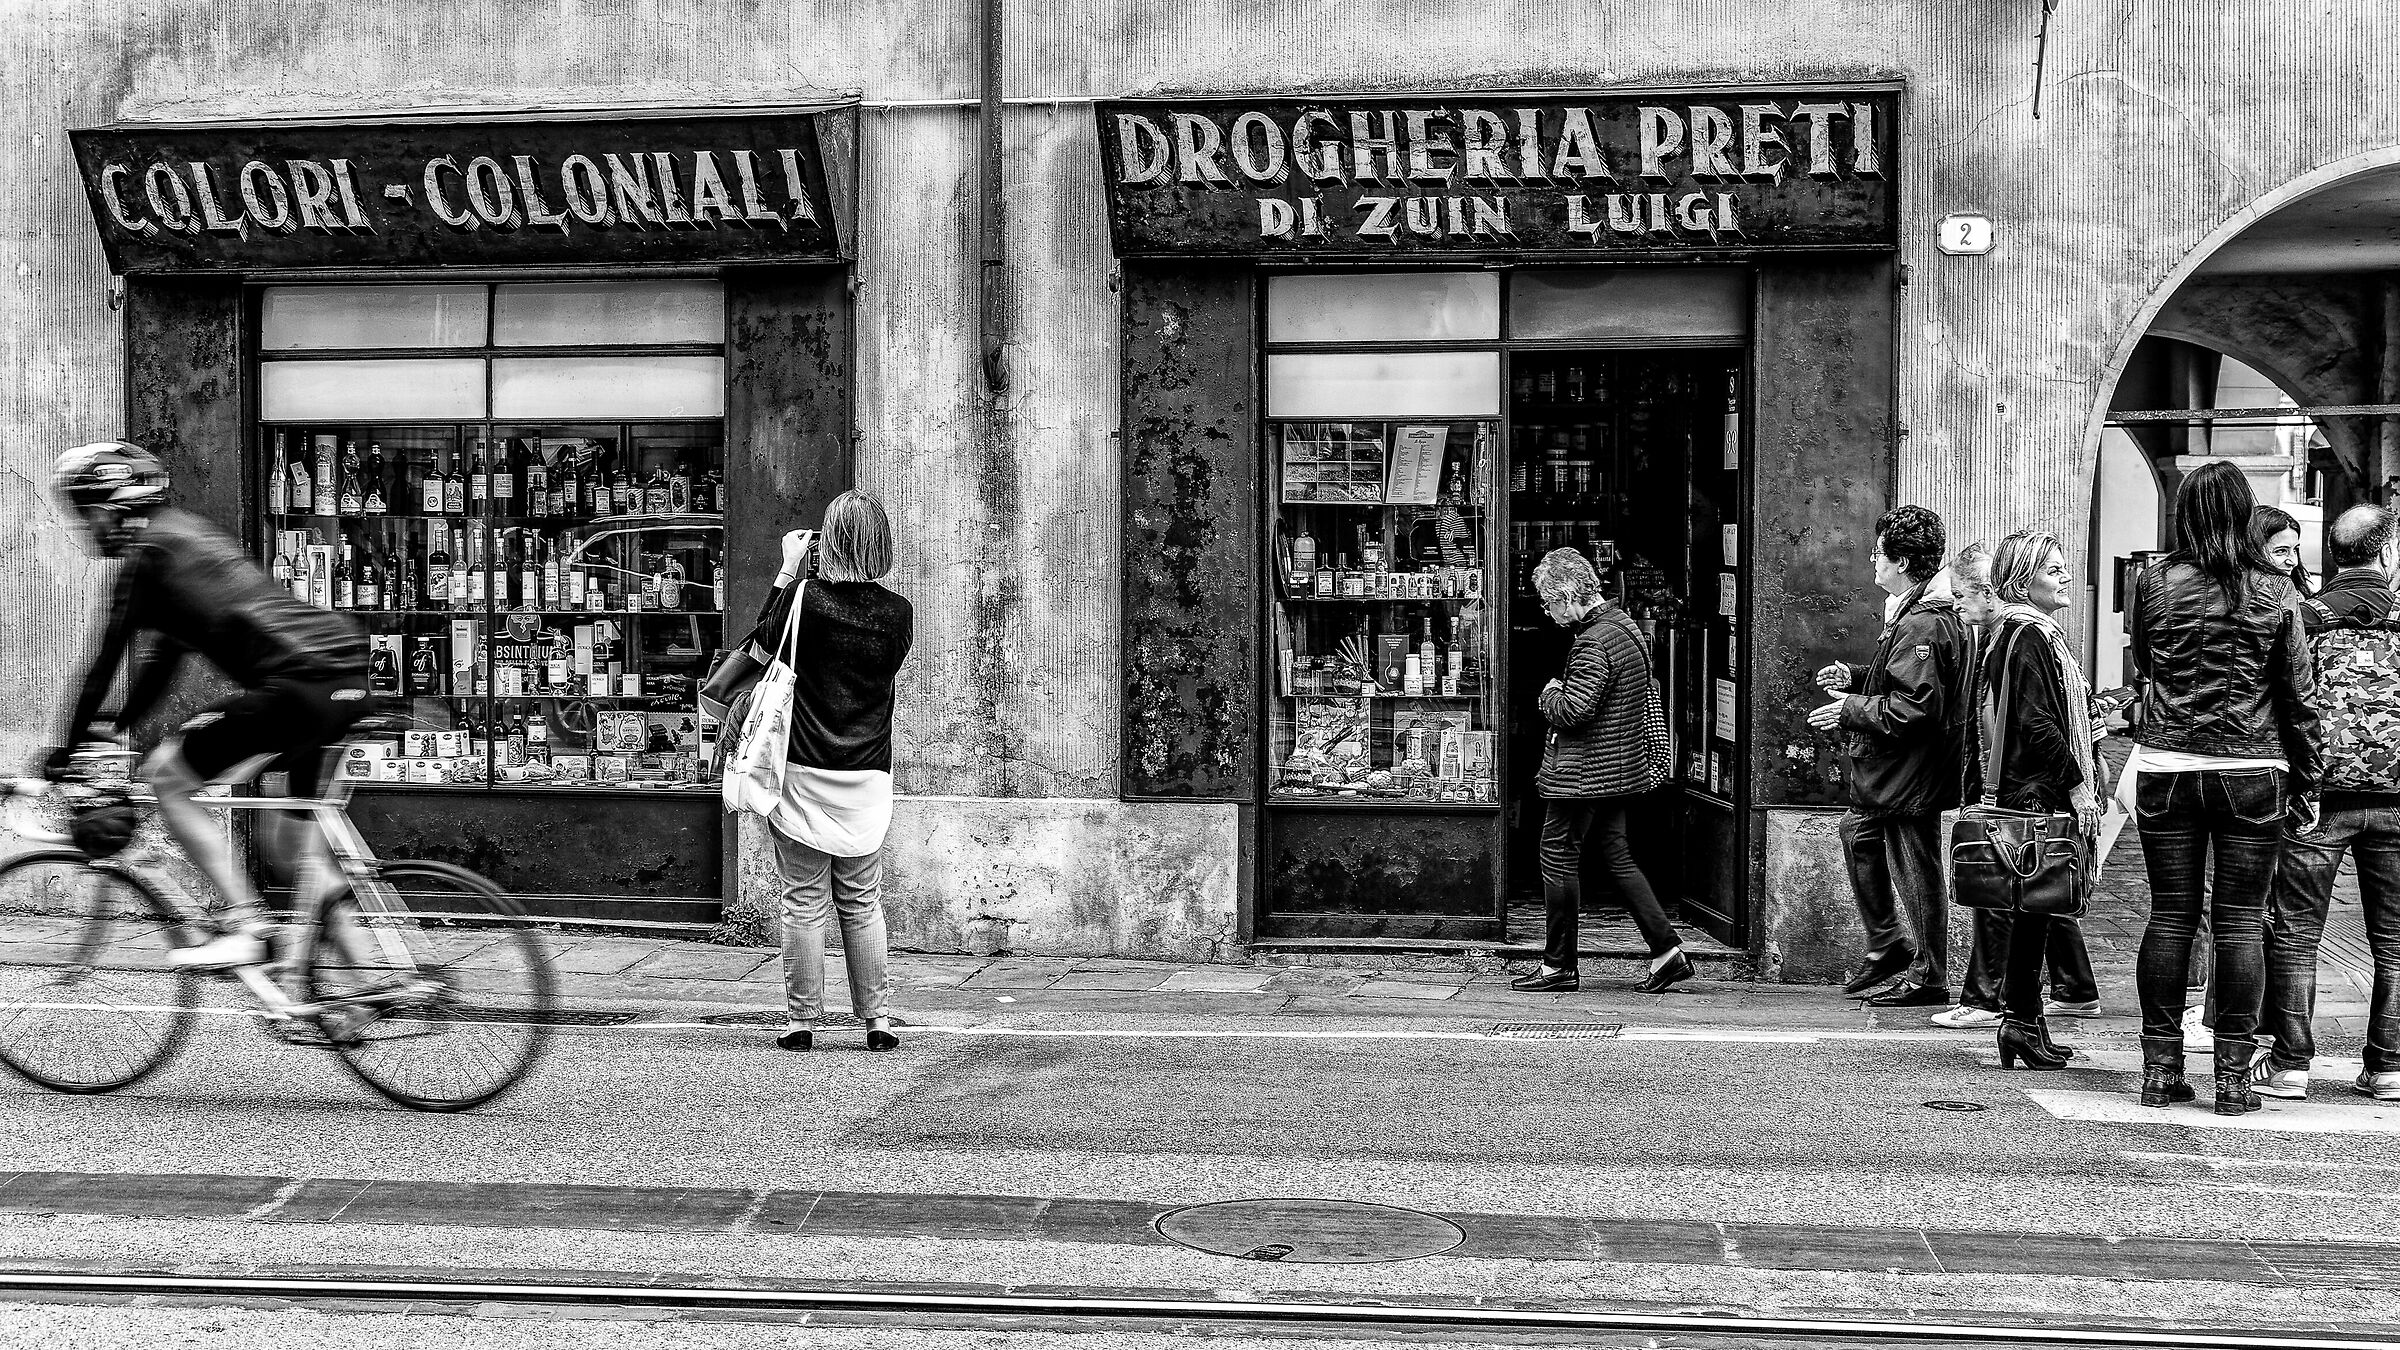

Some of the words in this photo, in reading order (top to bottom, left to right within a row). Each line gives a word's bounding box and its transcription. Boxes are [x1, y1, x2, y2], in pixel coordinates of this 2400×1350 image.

[1117, 105, 1618, 189] DROGHERIA
[1638, 101, 1884, 187] PRETI
[101, 157, 378, 241] COLORI
[423, 148, 816, 237] COLONIALI
[1354, 194, 1518, 246] ZUIN
[1567, 190, 1747, 246] LUIGI
[1960, 223, 1972, 246] 2
[494, 645, 552, 659] BSINTIU
